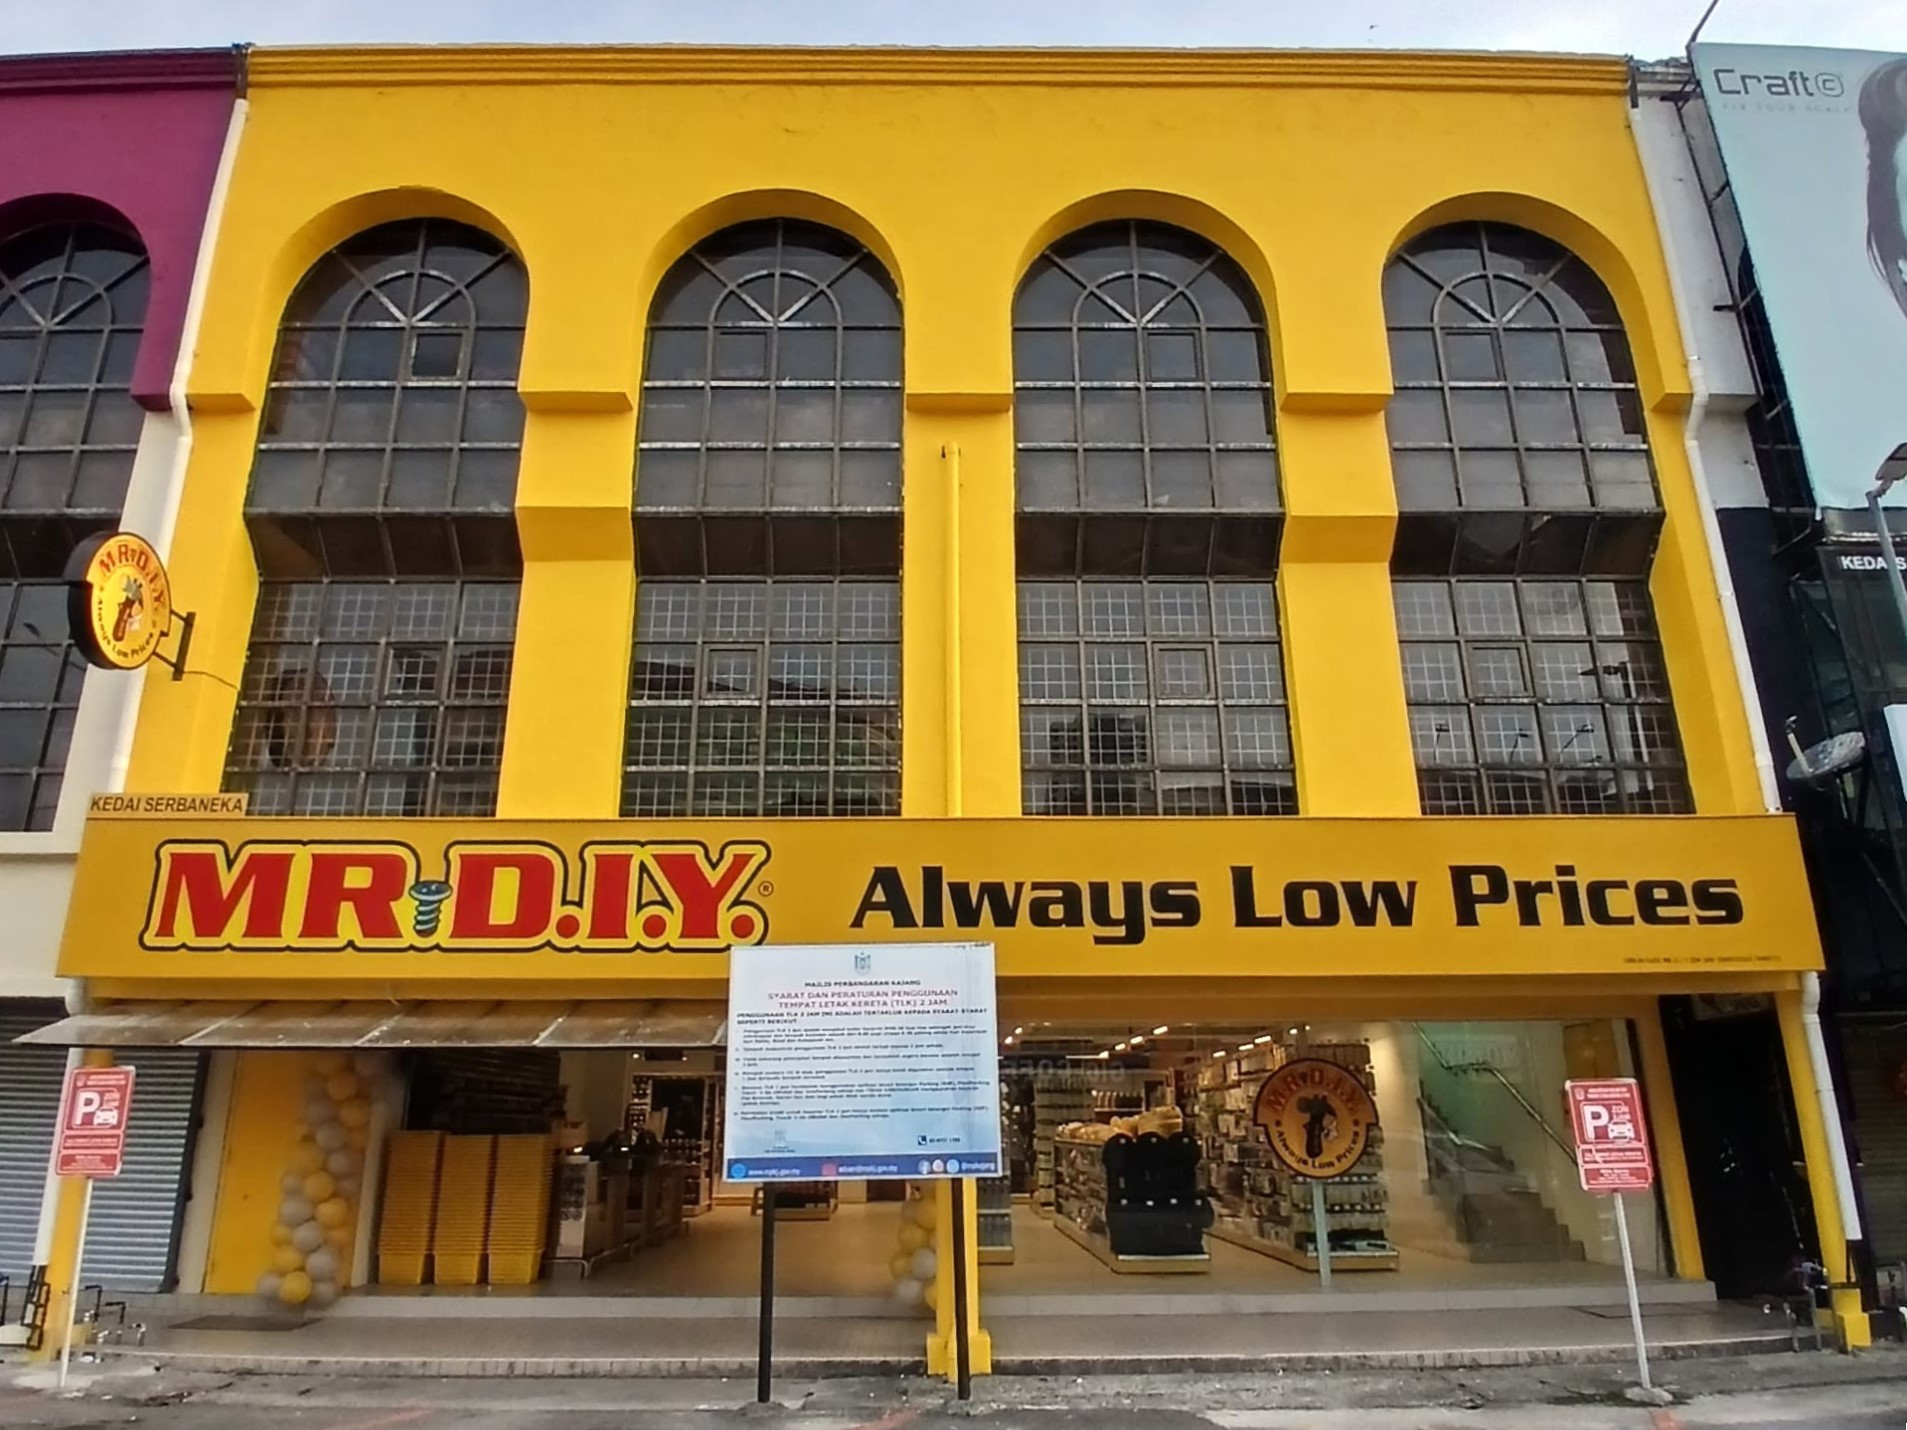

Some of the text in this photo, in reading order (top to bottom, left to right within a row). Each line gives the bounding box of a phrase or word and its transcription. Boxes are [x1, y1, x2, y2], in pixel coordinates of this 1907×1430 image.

[1840, 556, 1889, 570] KEDA
[90, 796, 244, 813] KEDAI SERBANEKA
[849, 864, 1744, 946] Always Low Prices
[768, 988, 958, 1000] SYARAT DAN PERATURAN PENGGUNAAN
[778, 1001, 817, 1009] TEMPAT
[818, 1000, 849, 1008] LETAK
[73, 1091, 101, 1126] P
[1582, 1104, 1610, 1141] P
